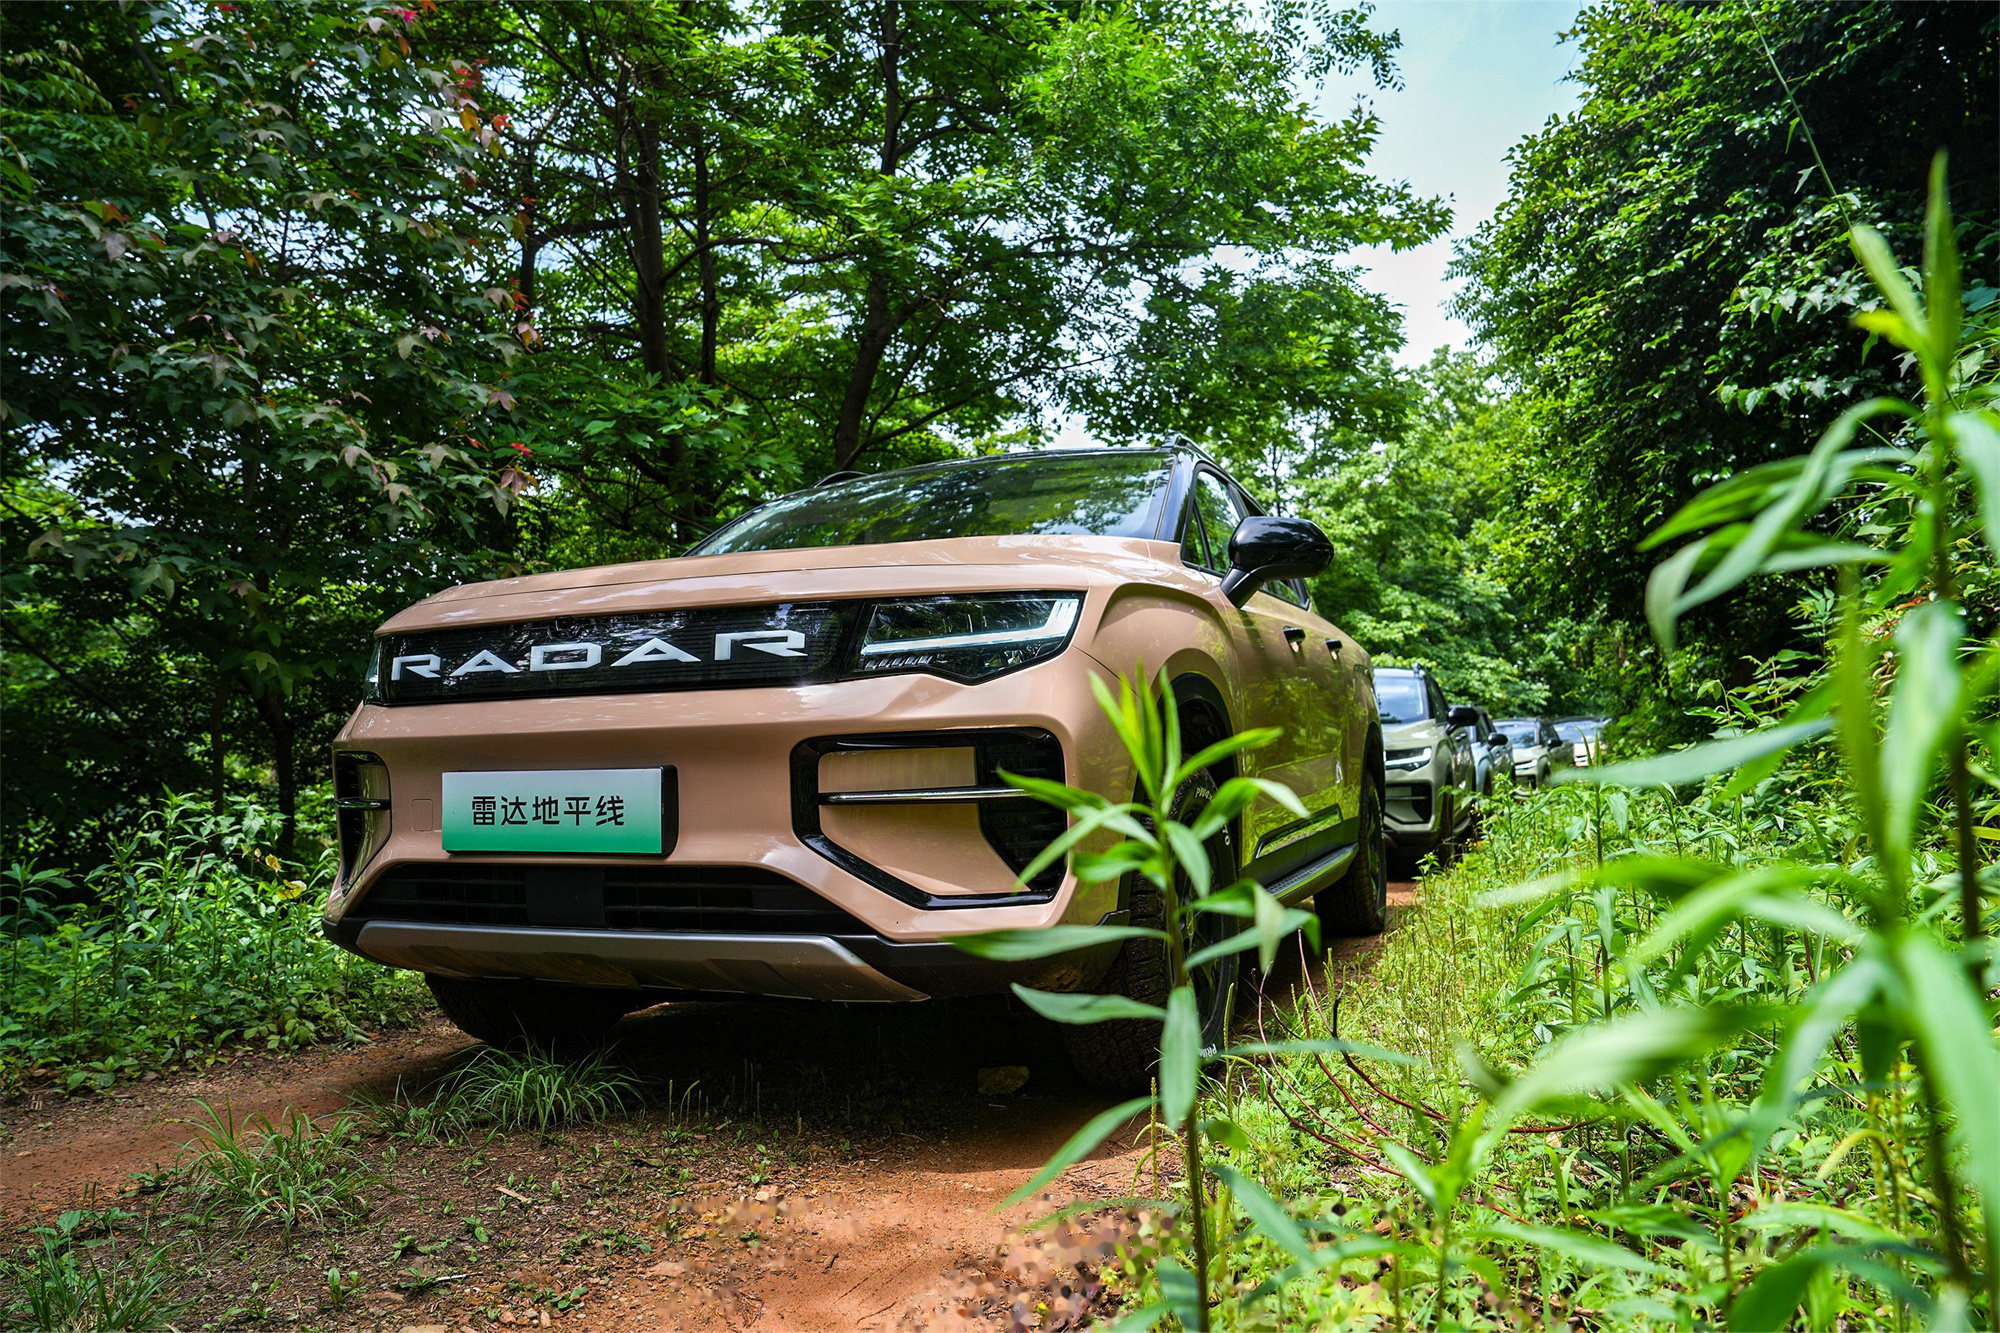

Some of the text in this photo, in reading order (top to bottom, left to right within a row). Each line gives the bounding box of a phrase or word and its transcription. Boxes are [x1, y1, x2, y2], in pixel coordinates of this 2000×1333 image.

[391, 629, 808, 681] RADAR
[471, 795, 625, 827] 雷达地平线
